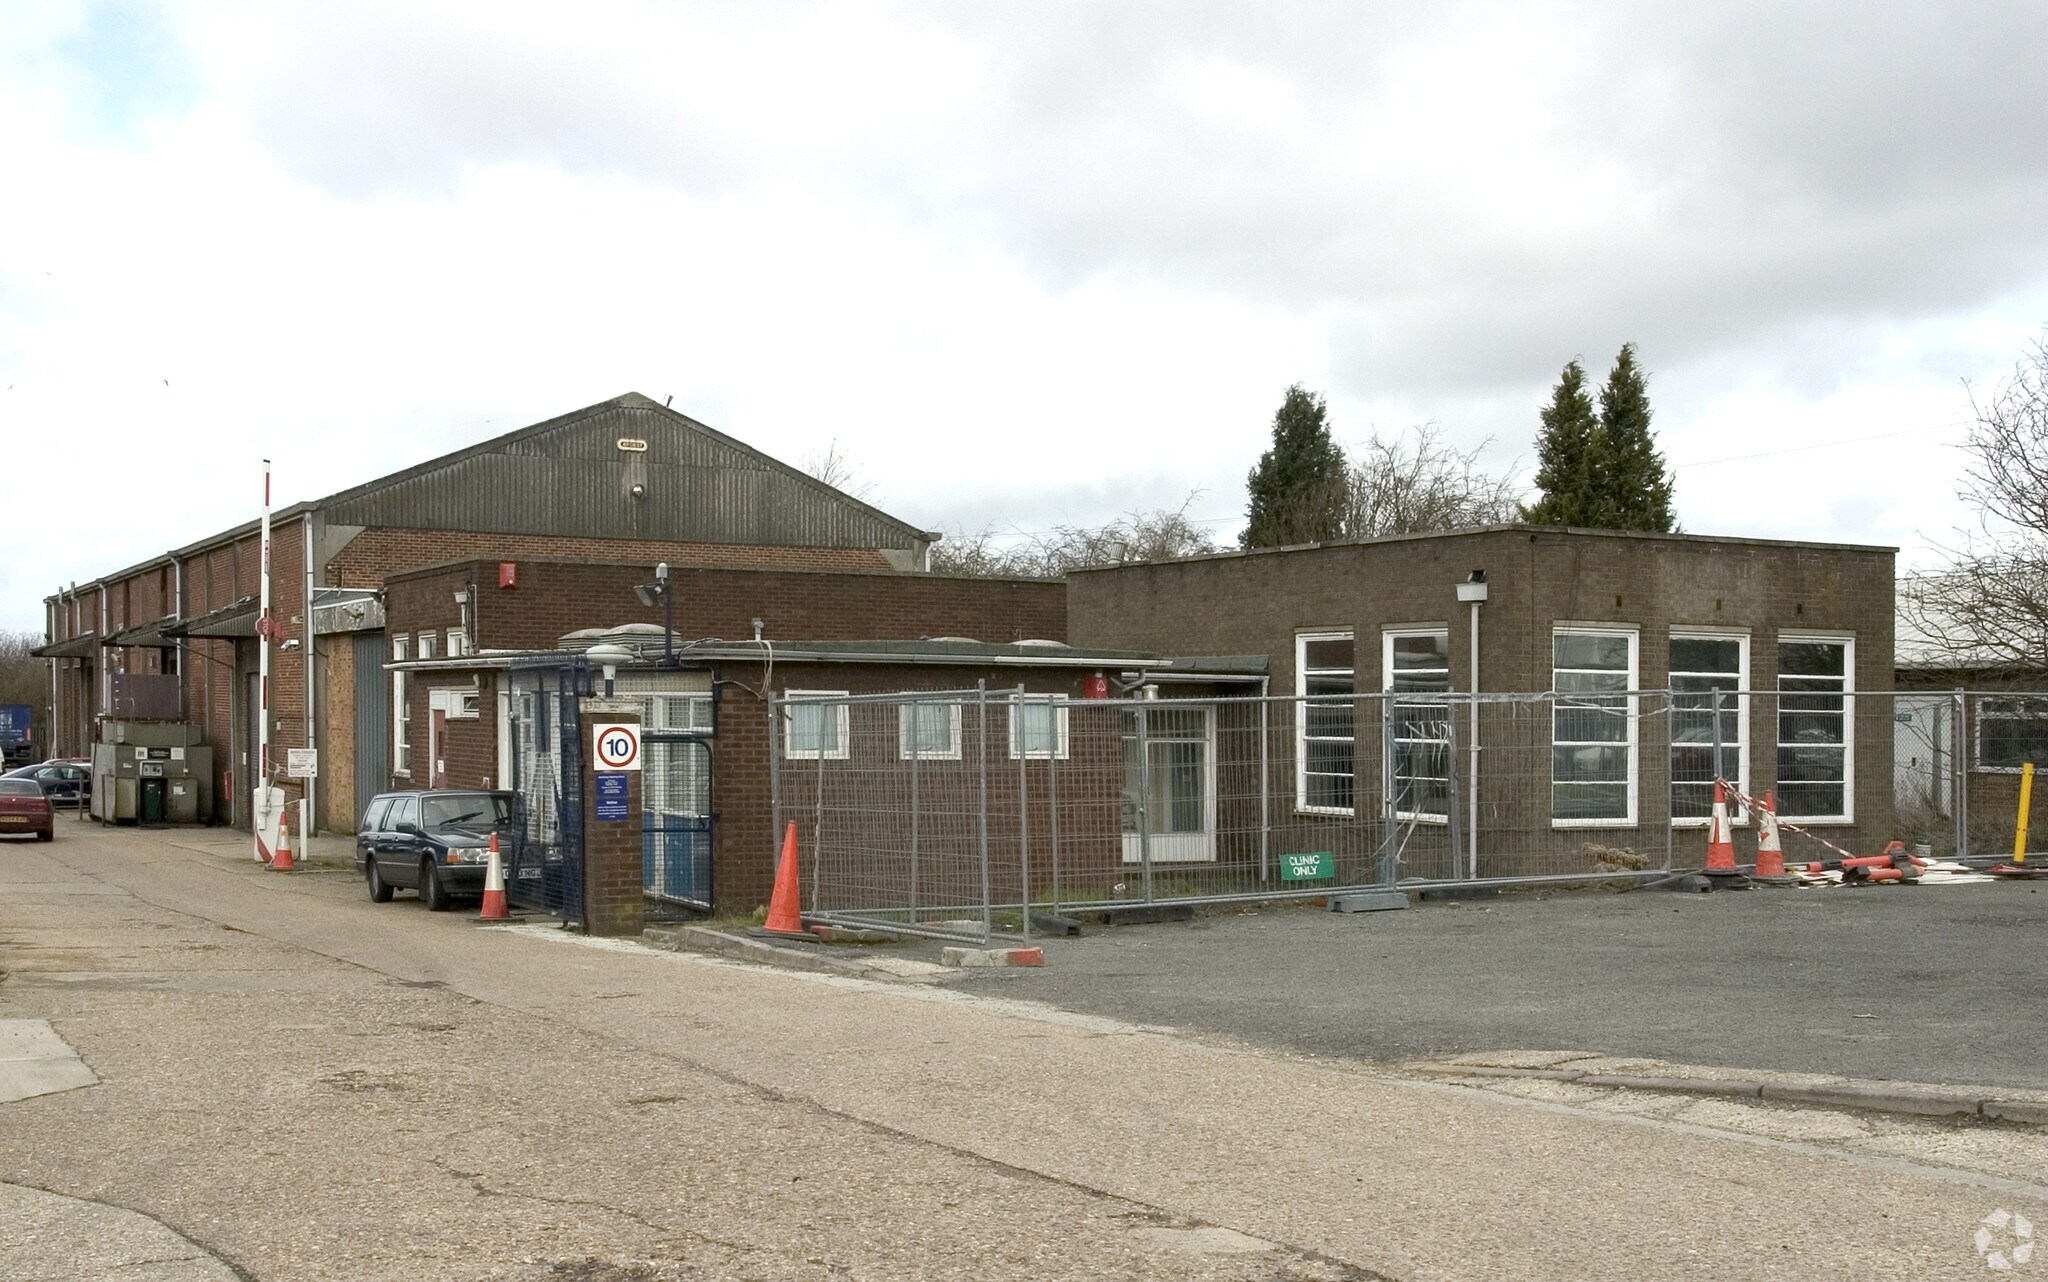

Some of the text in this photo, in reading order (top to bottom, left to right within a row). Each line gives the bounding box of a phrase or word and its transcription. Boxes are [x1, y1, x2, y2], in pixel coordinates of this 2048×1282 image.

[606, 738, 629, 756] 10
[1289, 855, 1320, 866] CLINIC
[1293, 866, 1318, 876] ONLY
